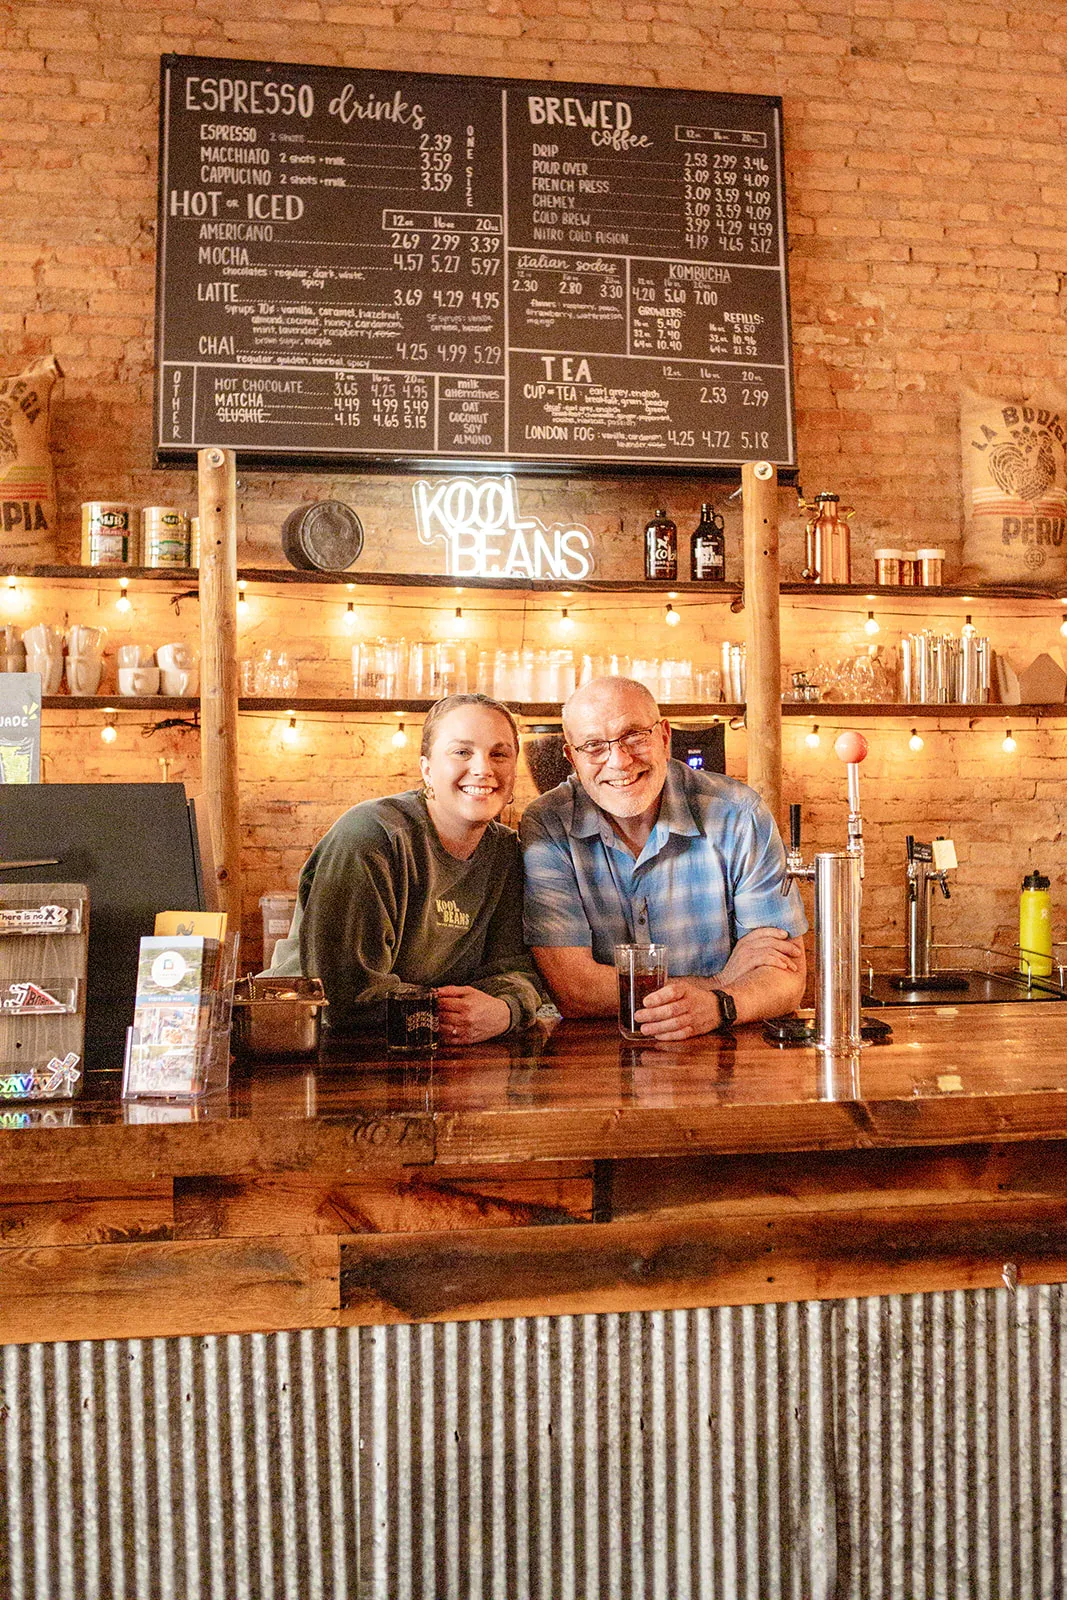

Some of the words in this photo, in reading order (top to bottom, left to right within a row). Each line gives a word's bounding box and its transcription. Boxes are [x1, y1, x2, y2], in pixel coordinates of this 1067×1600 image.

[186, 76, 314, 118] ESPRESSO
[328, 84, 426, 130] drinks
[528, 96, 632, 130] BREWED
[200, 124, 257, 142] ESPRESSO
[269, 133, 276, 142] 2
[419, 134, 452, 151] 2.39
[466, 125, 475, 160] ONE
[590, 129, 654, 151] coffee
[200, 147, 270, 165] MACCHIATO
[279, 152, 286, 163] 2
[289, 154, 316, 164] shots
[420, 152, 452, 172] 3.59
[532, 144, 559, 158] DRIP
[684, 152, 708, 168] 2.53
[713, 154, 738, 170] 2.99
[743, 156, 768, 172] 3.46
[200, 165, 271, 186] CAPPUCINO
[280, 174, 288, 184] 2
[290, 175, 317, 185] shots
[421, 172, 452, 192] 3.59
[465, 166, 474, 207] SIZE
[532, 160, 560, 176] POUR
[562, 162, 588, 176] OVER
[683, 168, 710, 183] 3.09
[714, 171, 738, 186] 3.59
[744, 174, 770, 188] 4.09
[532, 176, 575, 192] FRENCH
[578, 180, 610, 193] PRESS
[684, 185, 711, 200] 3.09
[714, 188, 740, 203] 3.59
[745, 190, 771, 204] 4.09
[170, 190, 222, 217] HOT
[247, 192, 304, 220] ICED
[532, 194, 576, 208] CHEMEX
[684, 202, 710, 217] 3.09
[715, 204, 742, 219] 3.59
[746, 206, 772, 221] 4.09
[532, 210, 558, 224] COLD
[562, 212, 590, 226] BREW
[685, 217, 710, 233] 3.99
[716, 219, 743, 235] 4.29
[748, 222, 773, 237] 4.59
[200, 224, 273, 242] AMERICANO
[431, 234, 460, 250] 2.99
[470, 236, 500, 253] 3.39
[533, 228, 564, 241] NITRO
[568, 230, 592, 243] COLD
[595, 231, 629, 244] FUSION
[685, 234, 709, 250] 4.19
[718, 236, 744, 252] 4.65
[750, 238, 772, 254] 5.12
[198, 246, 250, 266] MOCHA
[394, 254, 424, 271] 4.57
[432, 254, 460, 273] 5.27
[471, 258, 500, 276] 5.97
[517, 254, 570, 270] italian
[575, 258, 618, 274] sodas
[668, 264, 732, 282] KOMBUCHA
[198, 282, 240, 302] LATTE
[394, 289, 422, 306] 3.69
[433, 290, 464, 308] 4.29
[472, 292, 500, 308] 4.95
[301, 278, 324, 290] spicy
[512, 279, 538, 292] 2.30
[559, 281, 582, 294] 2.80
[600, 284, 623, 299] 3.30
[632, 287, 656, 302] 4.20
[664, 289, 686, 304] 5.60
[693, 290, 718, 306] 7.00
[224, 304, 254, 316] syrups
[656, 318, 681, 330] 5.40
[734, 324, 756, 334] 5.50
[658, 330, 681, 340] 7.40
[732, 334, 757, 346] 10.96
[199, 336, 235, 355] CHAI
[396, 343, 428, 360] 4.25
[437, 344, 467, 363] 4.99
[474, 346, 501, 364] 5.29
[656, 340, 682, 351] 10.40
[733, 346, 758, 356] 21.52
[540, 356, 592, 383] TEA
[214, 378, 238, 391] HOT
[242, 380, 303, 394] CHOCOLATE
[333, 382, 358, 396] 3.65
[371, 384, 396, 398] 4.25
[402, 385, 428, 399] 4.95
[444, 388, 500, 399] alternatives
[458, 380, 480, 389] milk
[523, 384, 546, 400] CUP
[556, 386, 578, 400] TEA
[700, 386, 728, 404] 2.53
[742, 389, 769, 406] 2.99
[172, 370, 182, 439] OTHER
[214, 393, 264, 408] MATCHA
[334, 398, 360, 412] 4.49
[372, 399, 398, 413] 4.99
[404, 400, 428, 415] 5.49
[462, 402, 480, 412] OAT
[334, 413, 360, 427] 4.15
[373, 414, 399, 428] 4.65
[404, 415, 427, 429] 5.15
[449, 412, 489, 424] COCONUT
[463, 424, 482, 434] SOY
[971, 424, 998, 451] LA
[1002, 406, 1067, 454] BODEG
[452, 434, 492, 446] ALMOND
[525, 424, 568, 440] LONDON
[574, 427, 595, 440] FOG
[668, 430, 695, 447] 4.25
[702, 430, 730, 448] 4.72
[741, 431, 769, 449] 5.18
[418, 476, 536, 539] KOOL
[1002, 516, 1066, 547] PERU
[451, 526, 590, 581] BEANS
[24, 912, 30, 920] is
[436, 900, 460, 912] KOOL
[444, 910, 470, 926] BEANS
